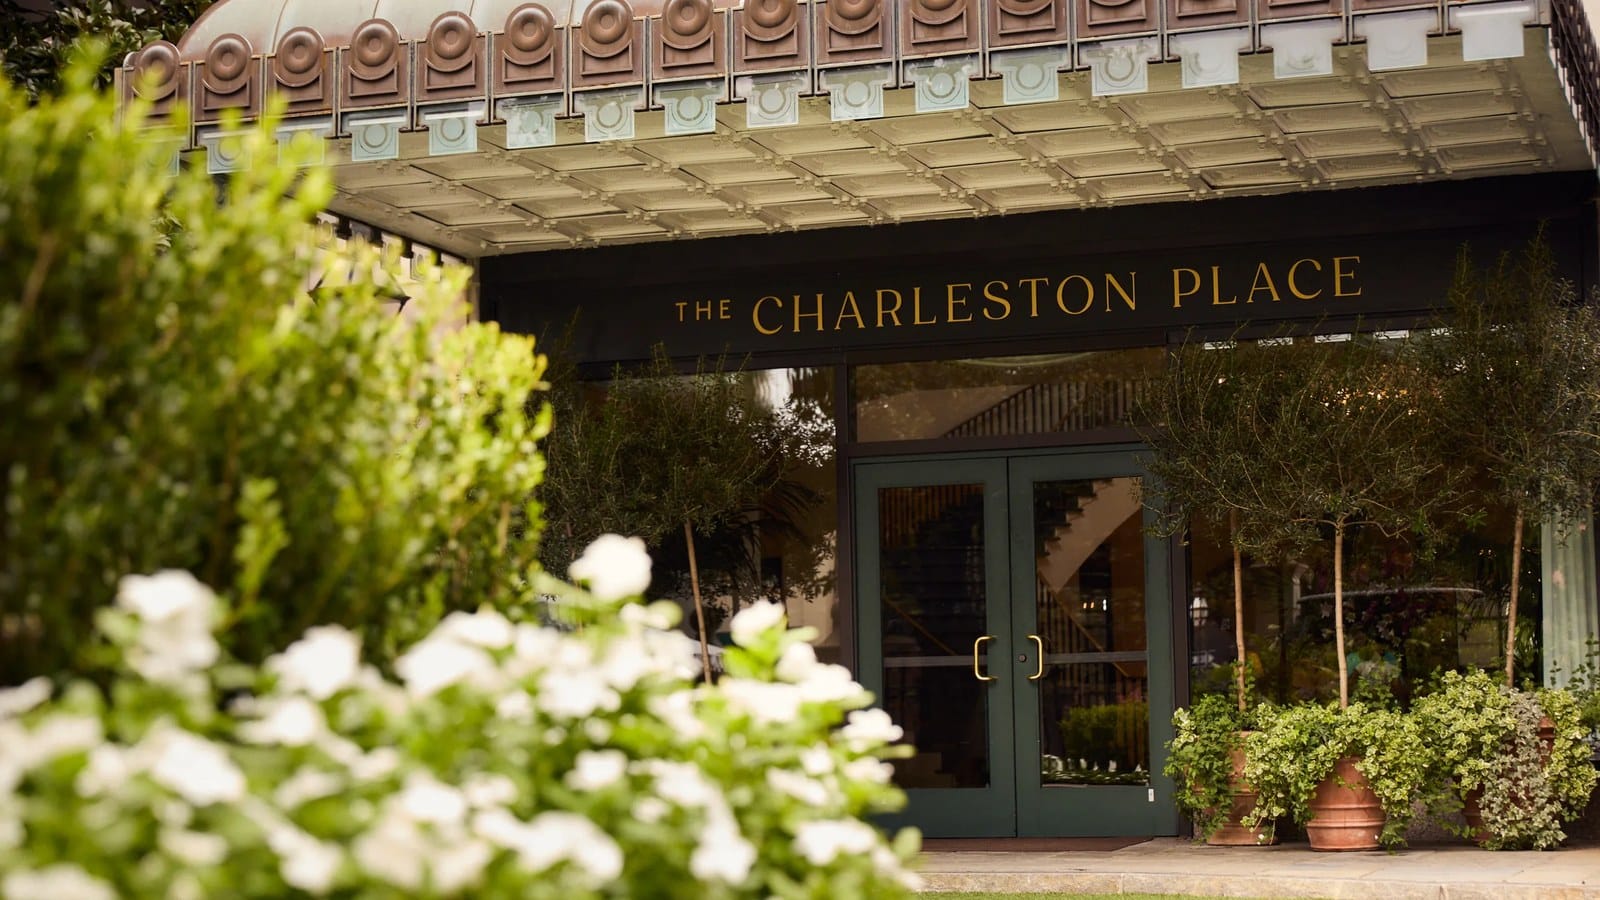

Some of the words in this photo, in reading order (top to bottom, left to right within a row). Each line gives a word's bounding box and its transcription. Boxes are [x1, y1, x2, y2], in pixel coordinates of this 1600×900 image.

[675, 299, 732, 322] THE
[751, 271, 1137, 335] CHARLESTON
[1172, 256, 1363, 308] PLACE
